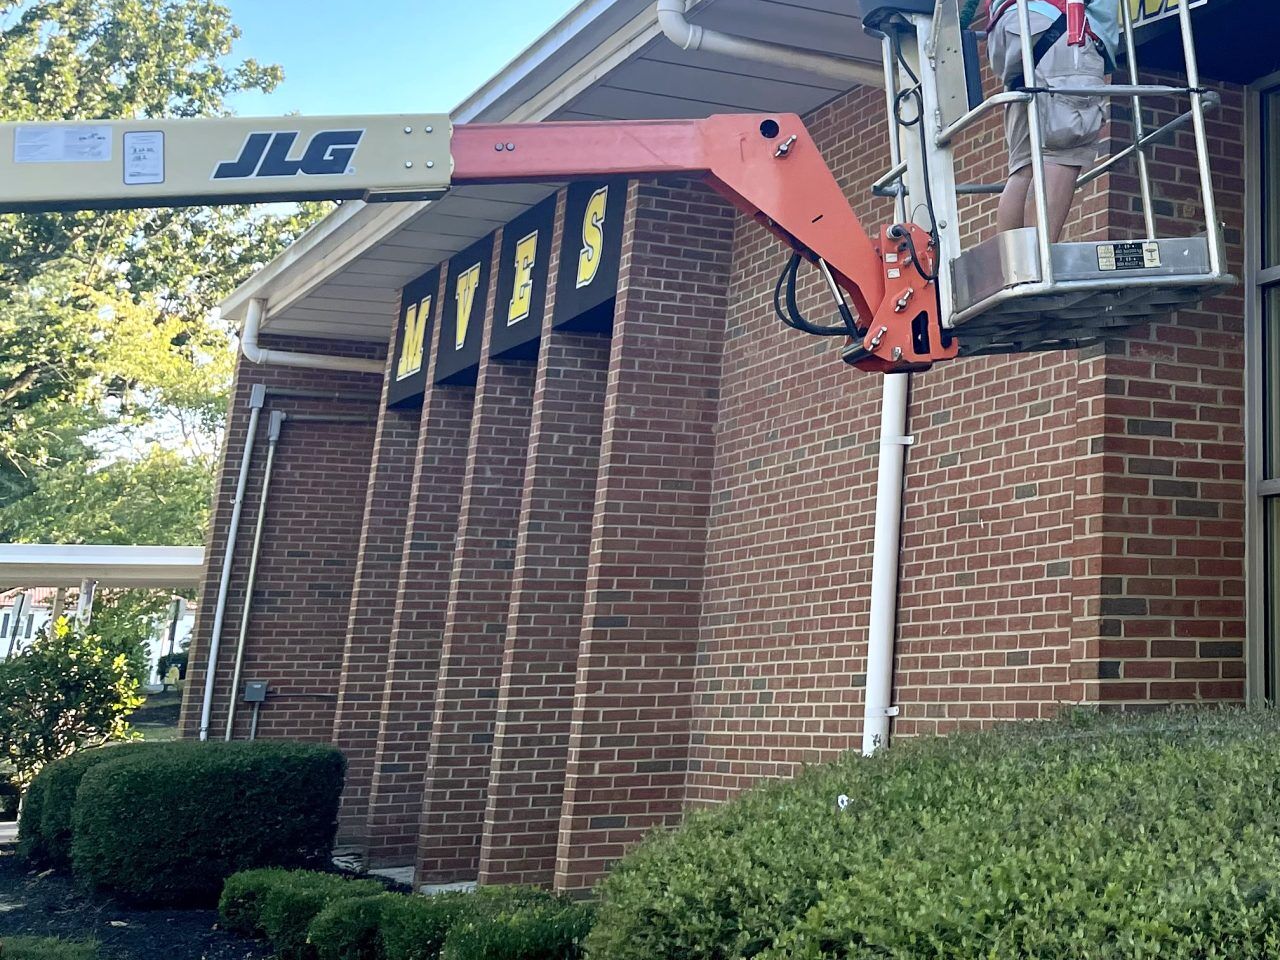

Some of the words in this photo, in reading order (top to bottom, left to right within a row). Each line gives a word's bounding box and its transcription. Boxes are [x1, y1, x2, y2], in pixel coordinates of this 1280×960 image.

[210, 128, 366, 180] JLG
[396, 294, 431, 381] M
[455, 261, 481, 350] V
[507, 229, 538, 327] E
[576, 185, 608, 289] S
